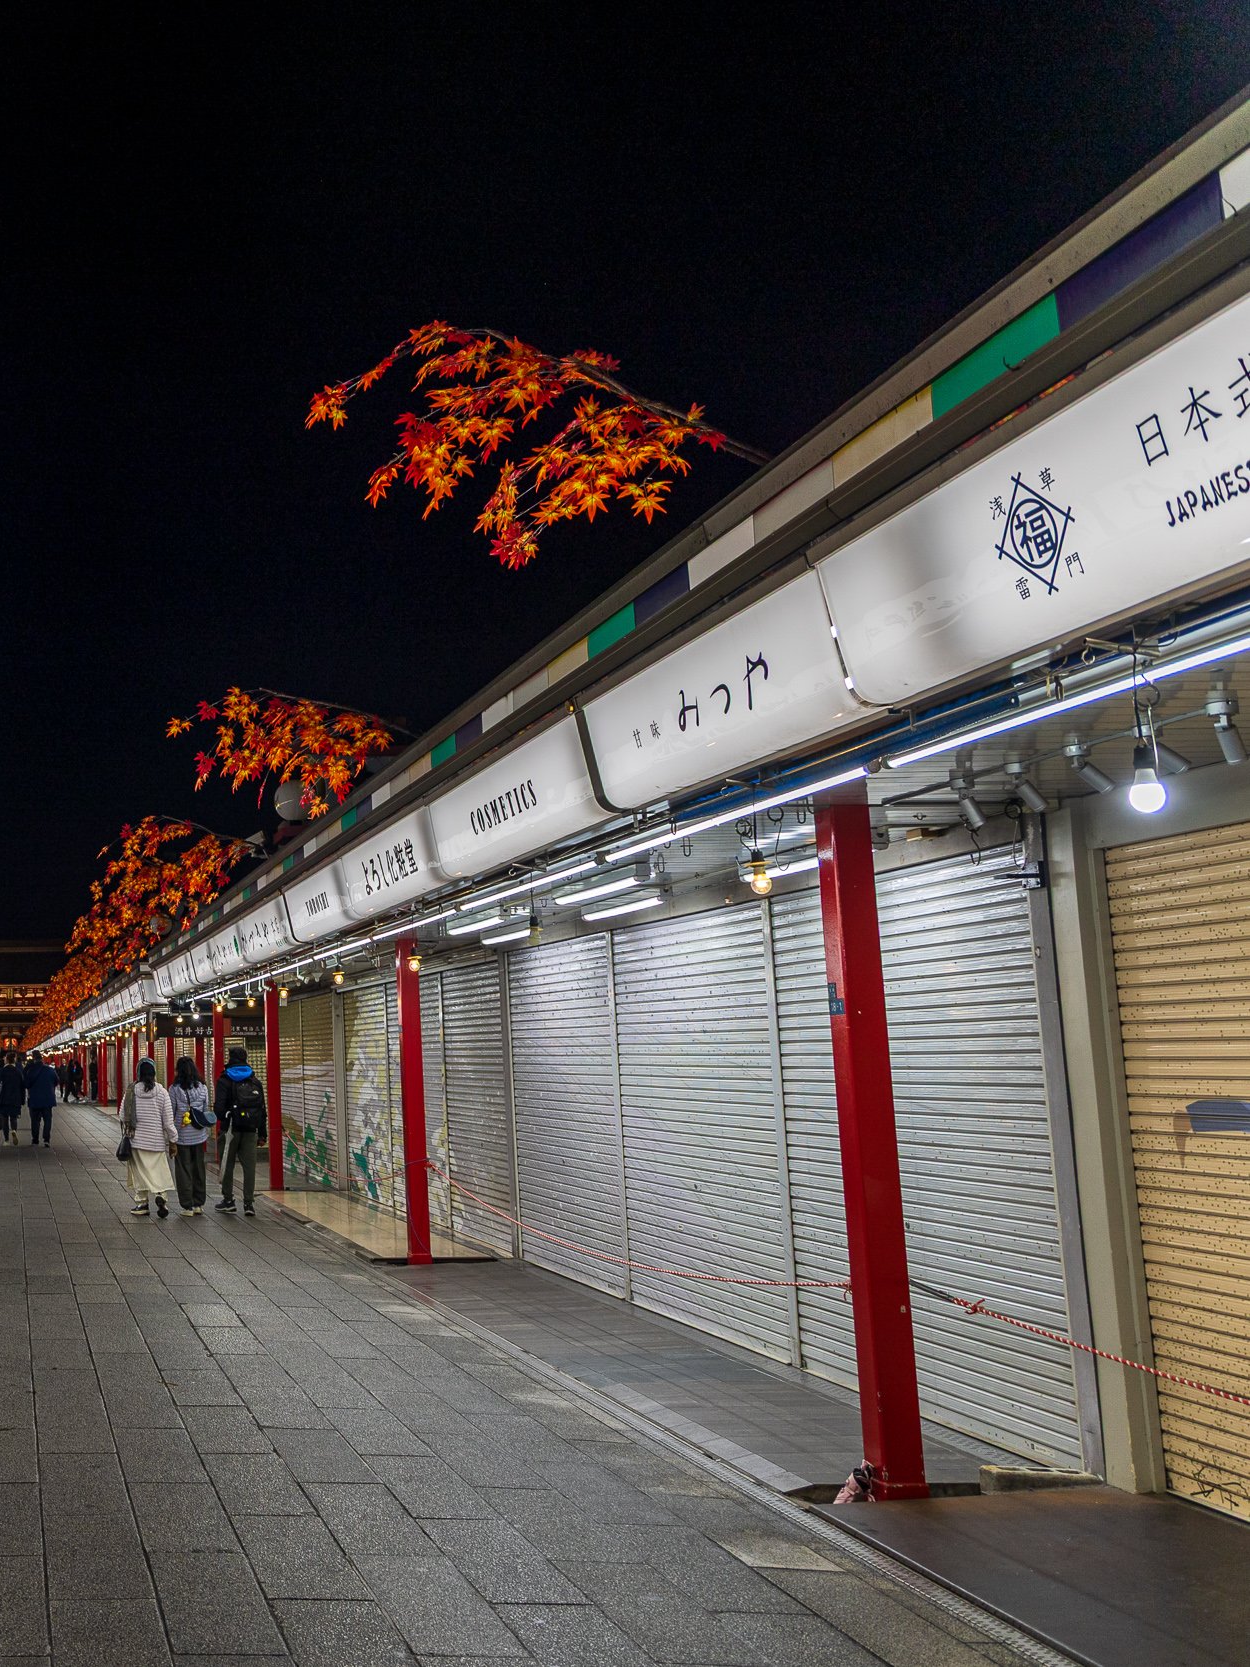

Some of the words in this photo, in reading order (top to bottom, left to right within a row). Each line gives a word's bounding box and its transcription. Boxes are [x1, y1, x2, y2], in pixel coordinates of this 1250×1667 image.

[1165, 460, 1250, 528] JAPANES
[1014, 505, 1055, 563] 福
[632, 719, 661, 749] 甘味
[677, 651, 769, 733] みつや
[470, 778, 538, 836] COSMETICS
[361, 838, 420, 896] よろし化粧堂
[305, 891, 330, 917] YOROSHI
